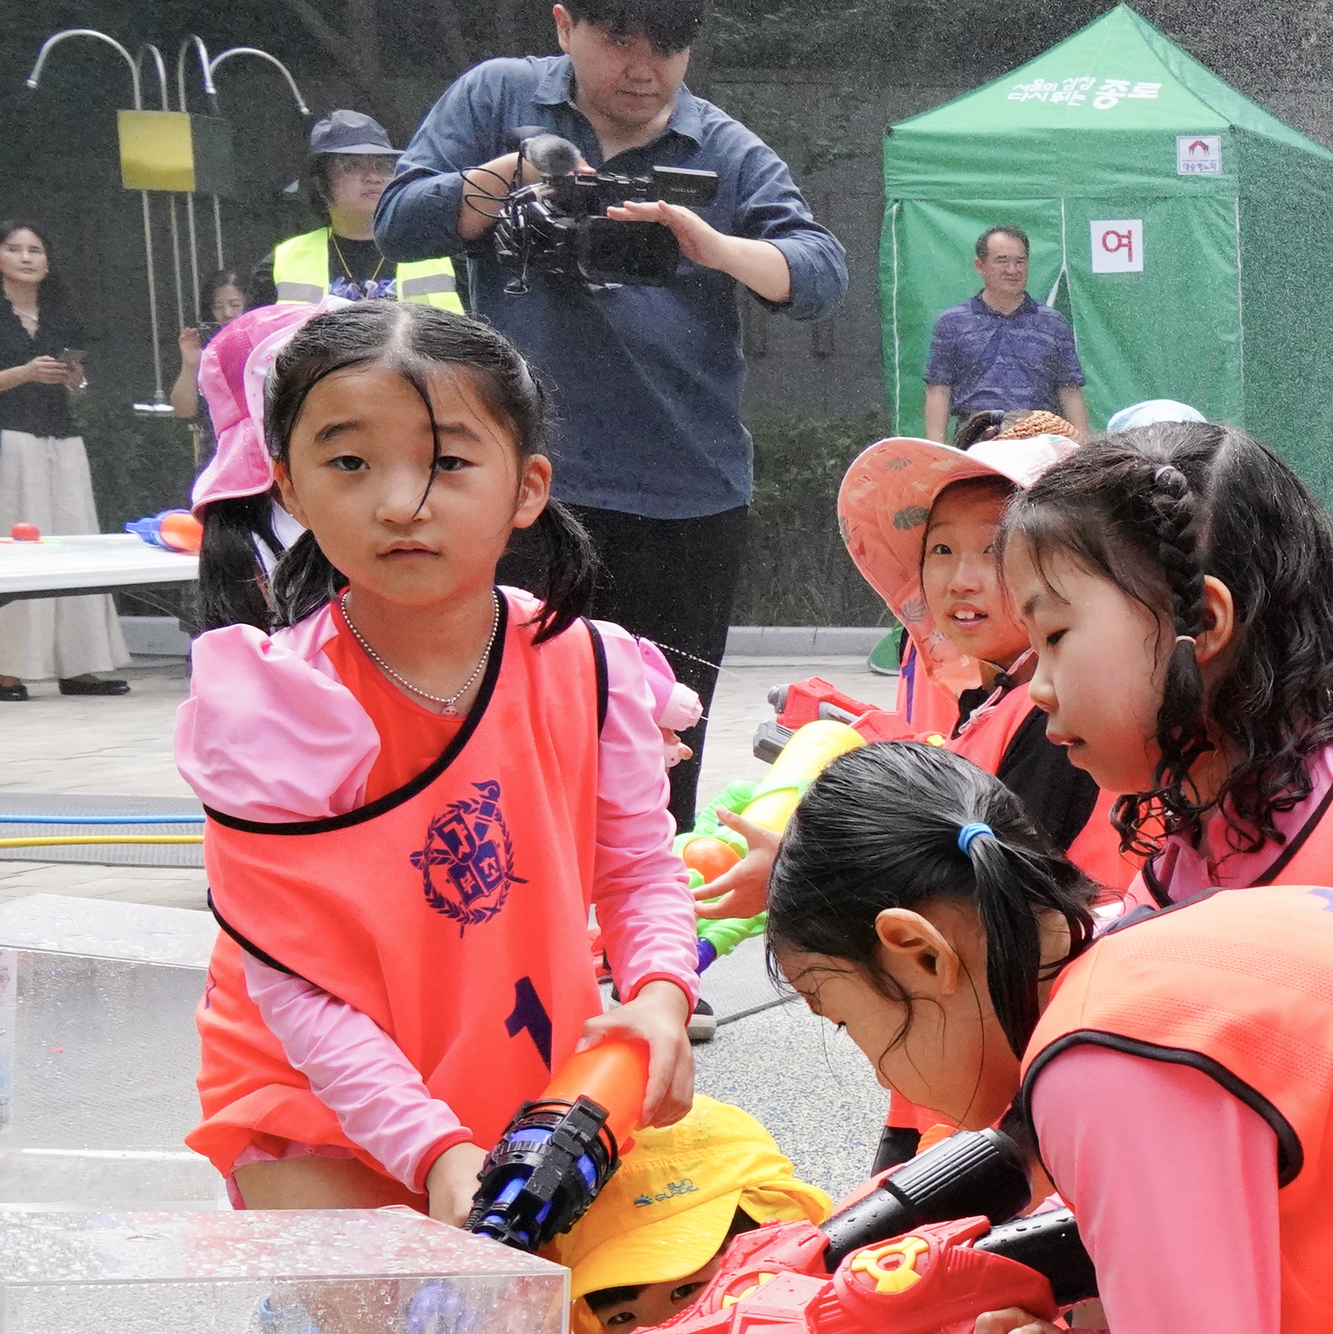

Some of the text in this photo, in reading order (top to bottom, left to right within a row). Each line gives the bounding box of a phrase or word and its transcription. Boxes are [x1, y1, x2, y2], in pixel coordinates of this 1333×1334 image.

[1012, 76, 1097, 92] 서울의 심장
[1092, 79, 1163, 110] 종로
[1007, 90, 1087, 107] 다시 뛰는
[1102, 229, 1133, 263] 여
